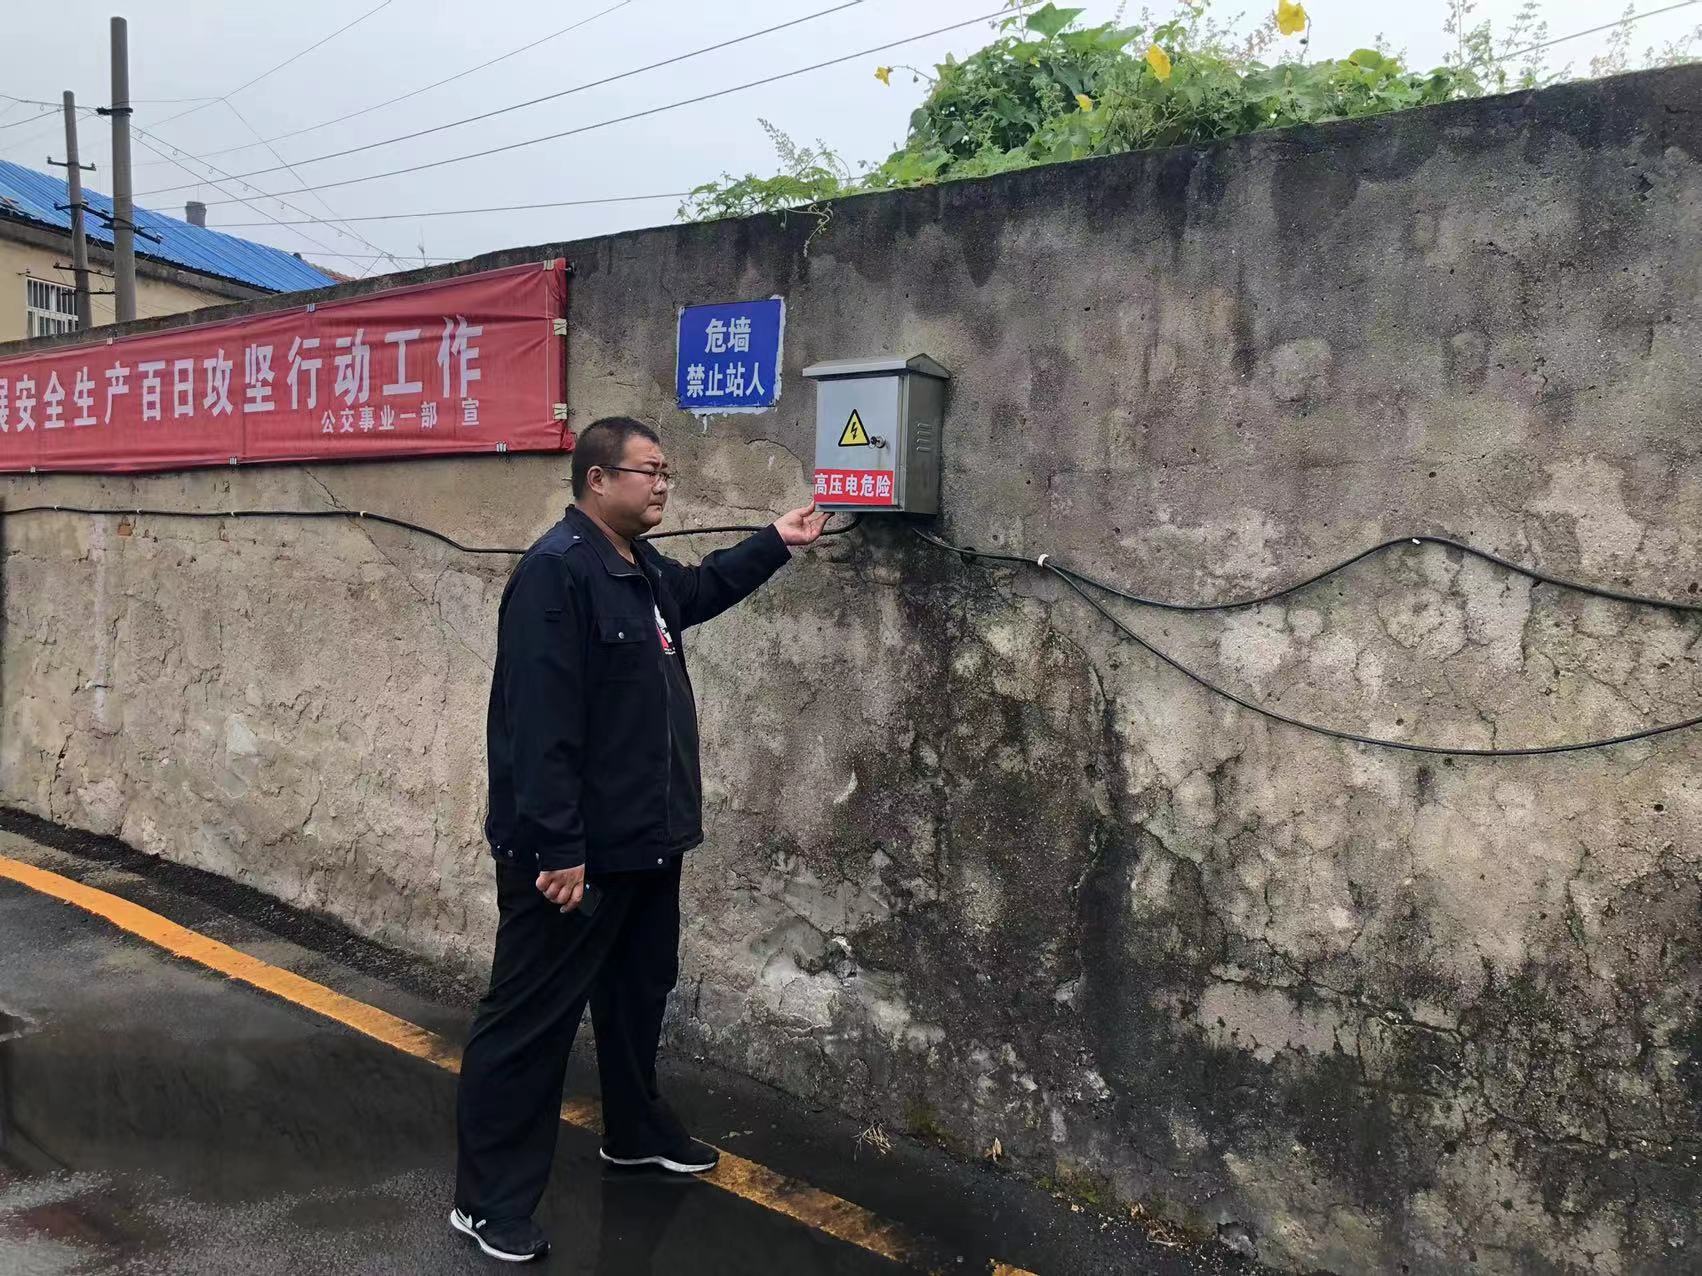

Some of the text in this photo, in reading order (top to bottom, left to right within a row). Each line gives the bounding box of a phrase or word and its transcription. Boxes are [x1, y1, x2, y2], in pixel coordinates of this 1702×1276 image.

[704, 316, 751, 353] 危墙
[686, 362, 765, 398] 禁止站人
[321, 398, 480, 433] 公交事业一部 宣
[814, 473, 891, 497] 高压电危险
